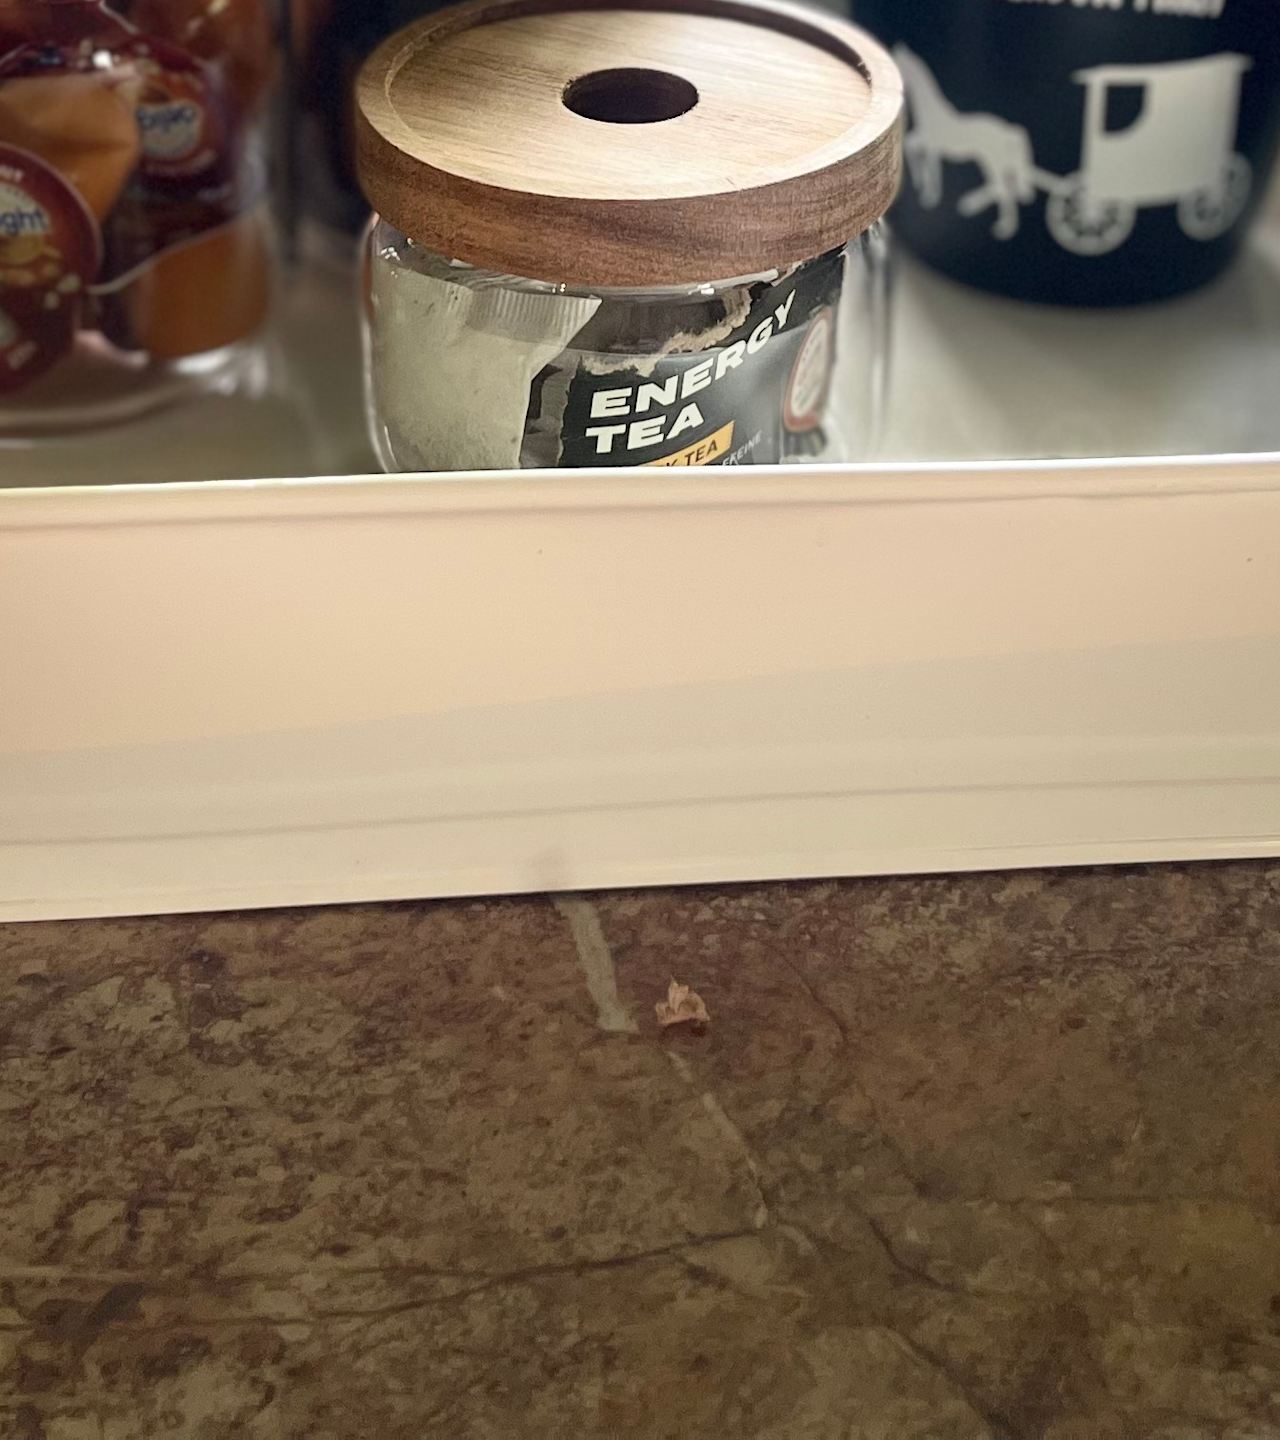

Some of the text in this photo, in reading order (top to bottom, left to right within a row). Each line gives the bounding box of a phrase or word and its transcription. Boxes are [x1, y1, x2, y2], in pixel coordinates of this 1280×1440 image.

[589, 289, 797, 420] ENERGY
[585, 402, 706, 454] TEA
[683, 438, 719, 466] TEA
